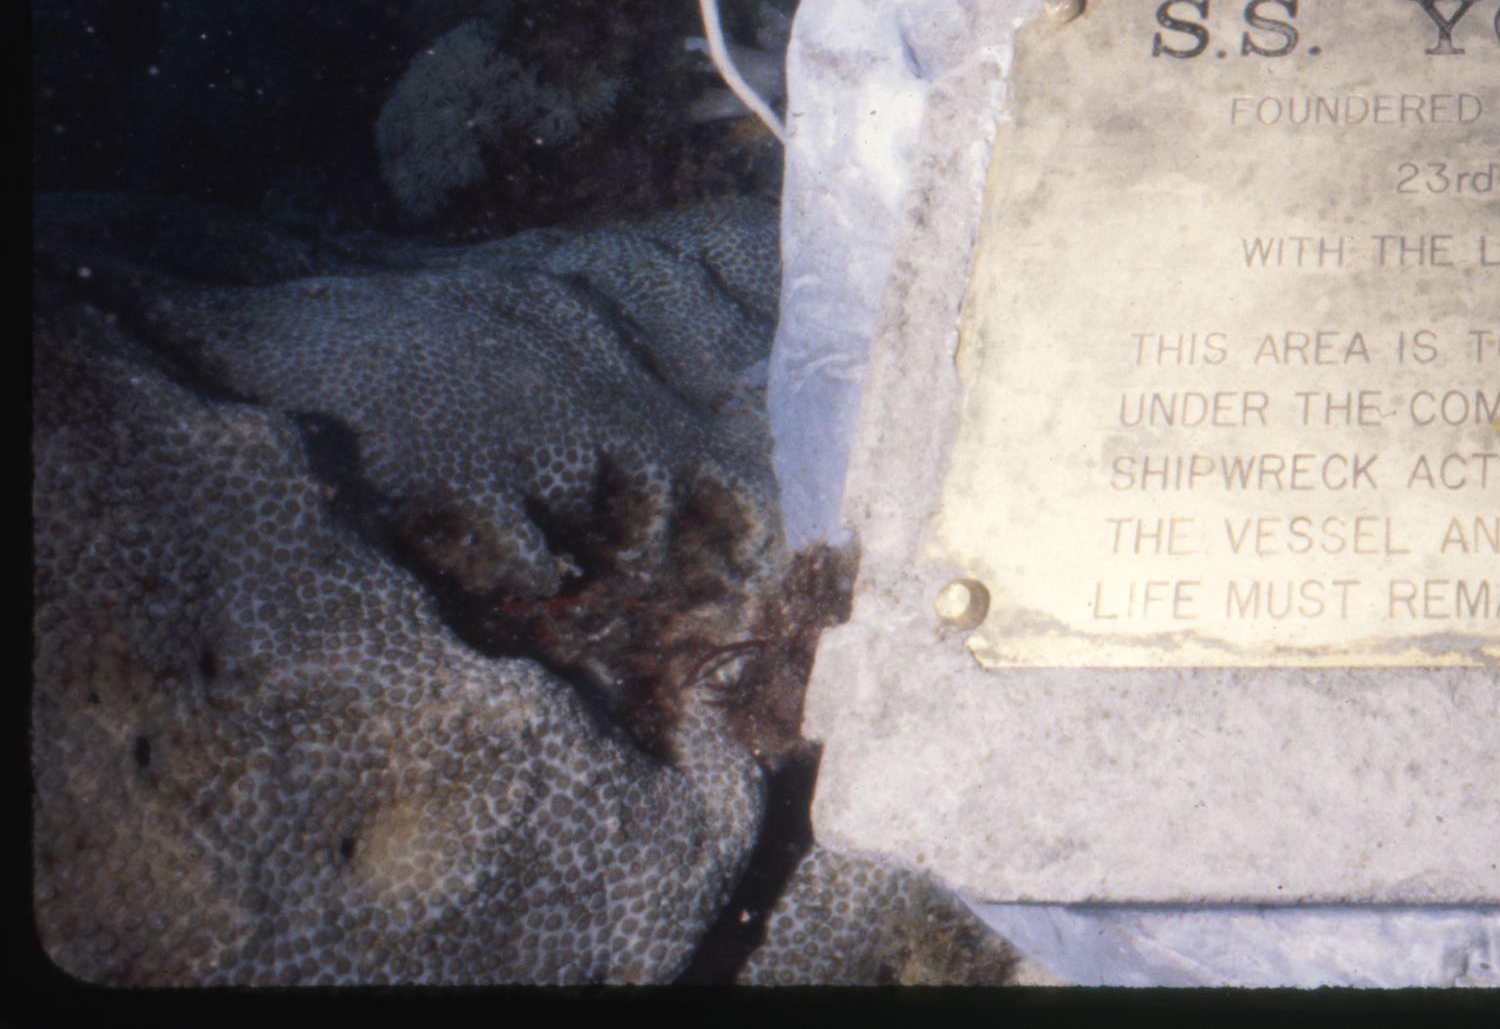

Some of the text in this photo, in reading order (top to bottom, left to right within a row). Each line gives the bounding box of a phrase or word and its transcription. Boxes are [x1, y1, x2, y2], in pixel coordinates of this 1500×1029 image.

[1231, 92, 1482, 125] FOUNDERED
[1396, 162, 1494, 194] 23rd
[1242, 236, 1344, 268] WITH
[1371, 235, 1454, 268] THE
[1131, 331, 1229, 366] THIS
[1255, 330, 1370, 365] AREA
[1399, 329, 1439, 364] IS
[1118, 391, 1269, 427] UNDER
[1295, 390, 1382, 426] THE
[1109, 453, 1379, 492] SHIPWRECK
[1105, 517, 1194, 555] THE
[1224, 516, 1411, 555] VESSEL
[1092, 580, 1201, 620] LIFE
[1226, 580, 1361, 620] MUST
